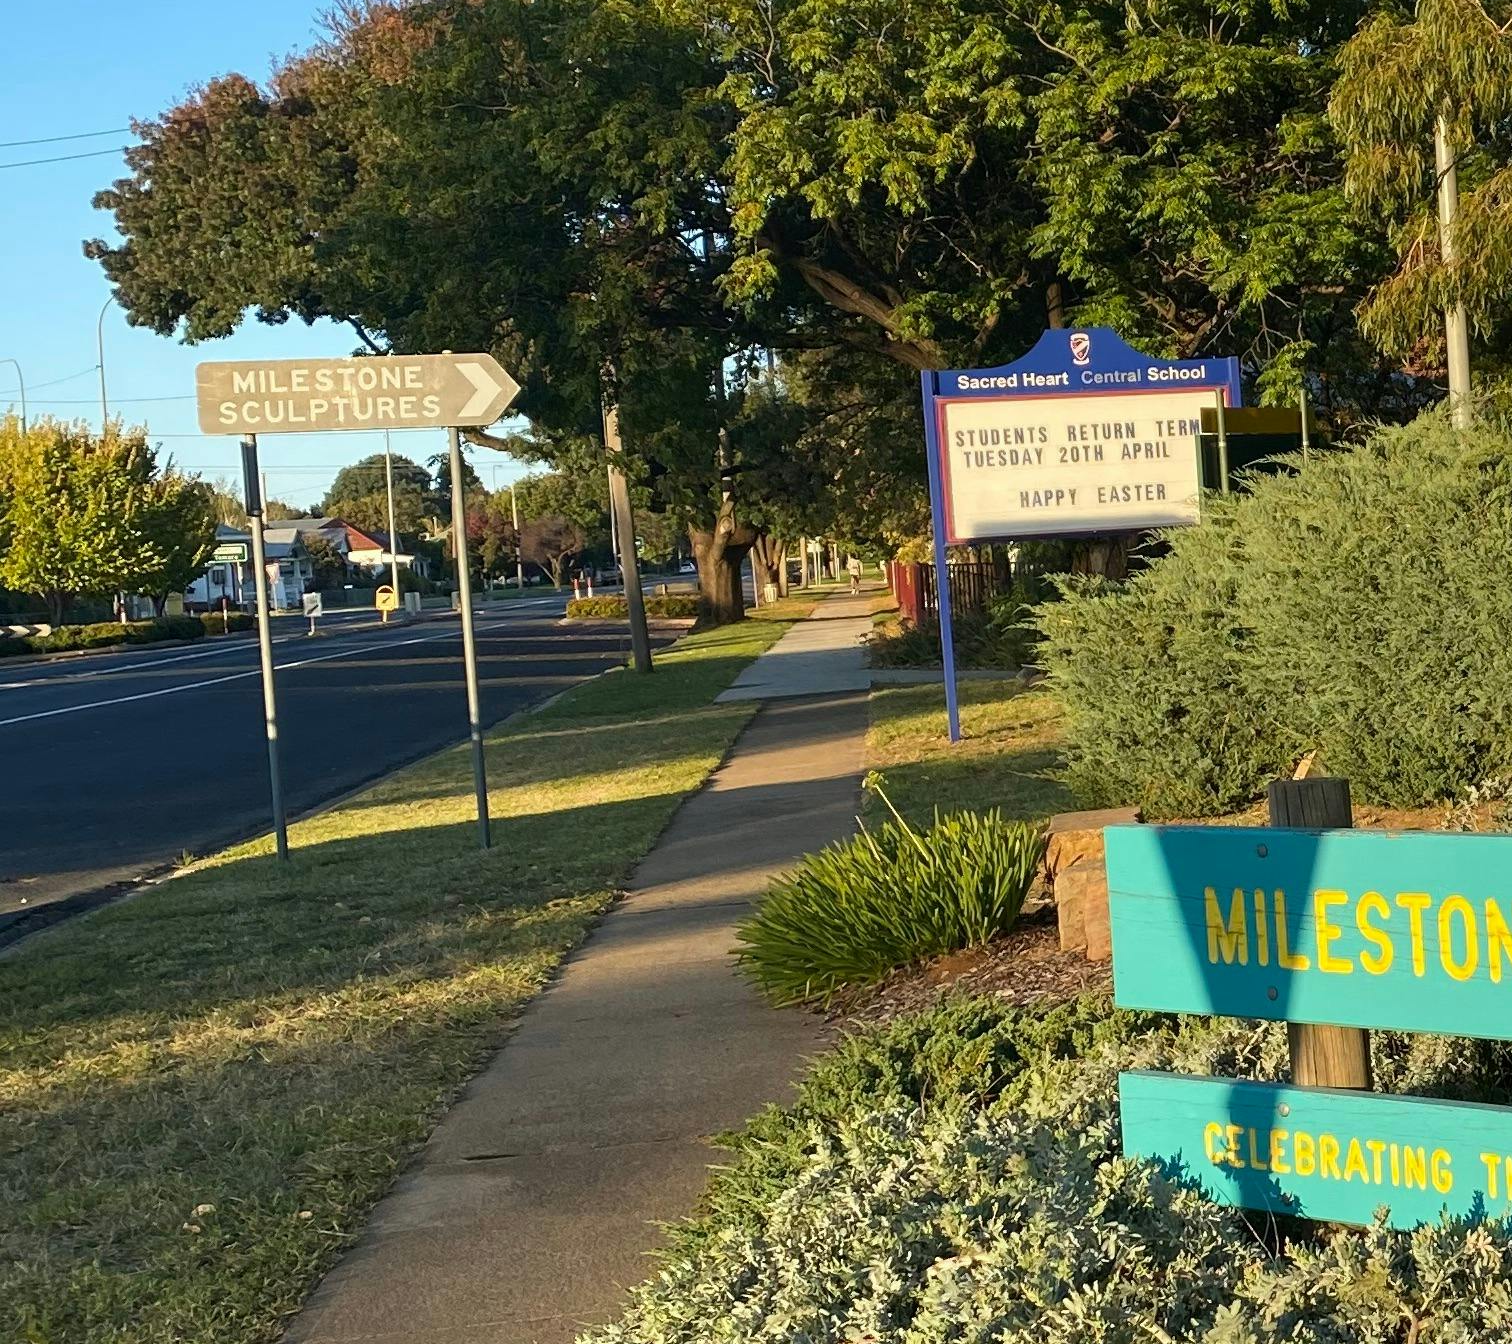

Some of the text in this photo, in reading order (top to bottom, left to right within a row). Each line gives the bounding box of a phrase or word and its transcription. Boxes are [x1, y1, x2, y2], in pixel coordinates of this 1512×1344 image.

[232, 365, 424, 394] MILESTONE
[957, 365, 1206, 390] Sacred Heart Central School
[219, 394, 442, 425] SCULPTURES
[955, 419, 1200, 448] STUDENTS RETURN TERM
[963, 441, 1171, 469] TUESDAY 20TH APRIL
[1020, 484, 1166, 508] HAPPY EASTER
[1204, 1121, 1453, 1195] CELEBRATING
